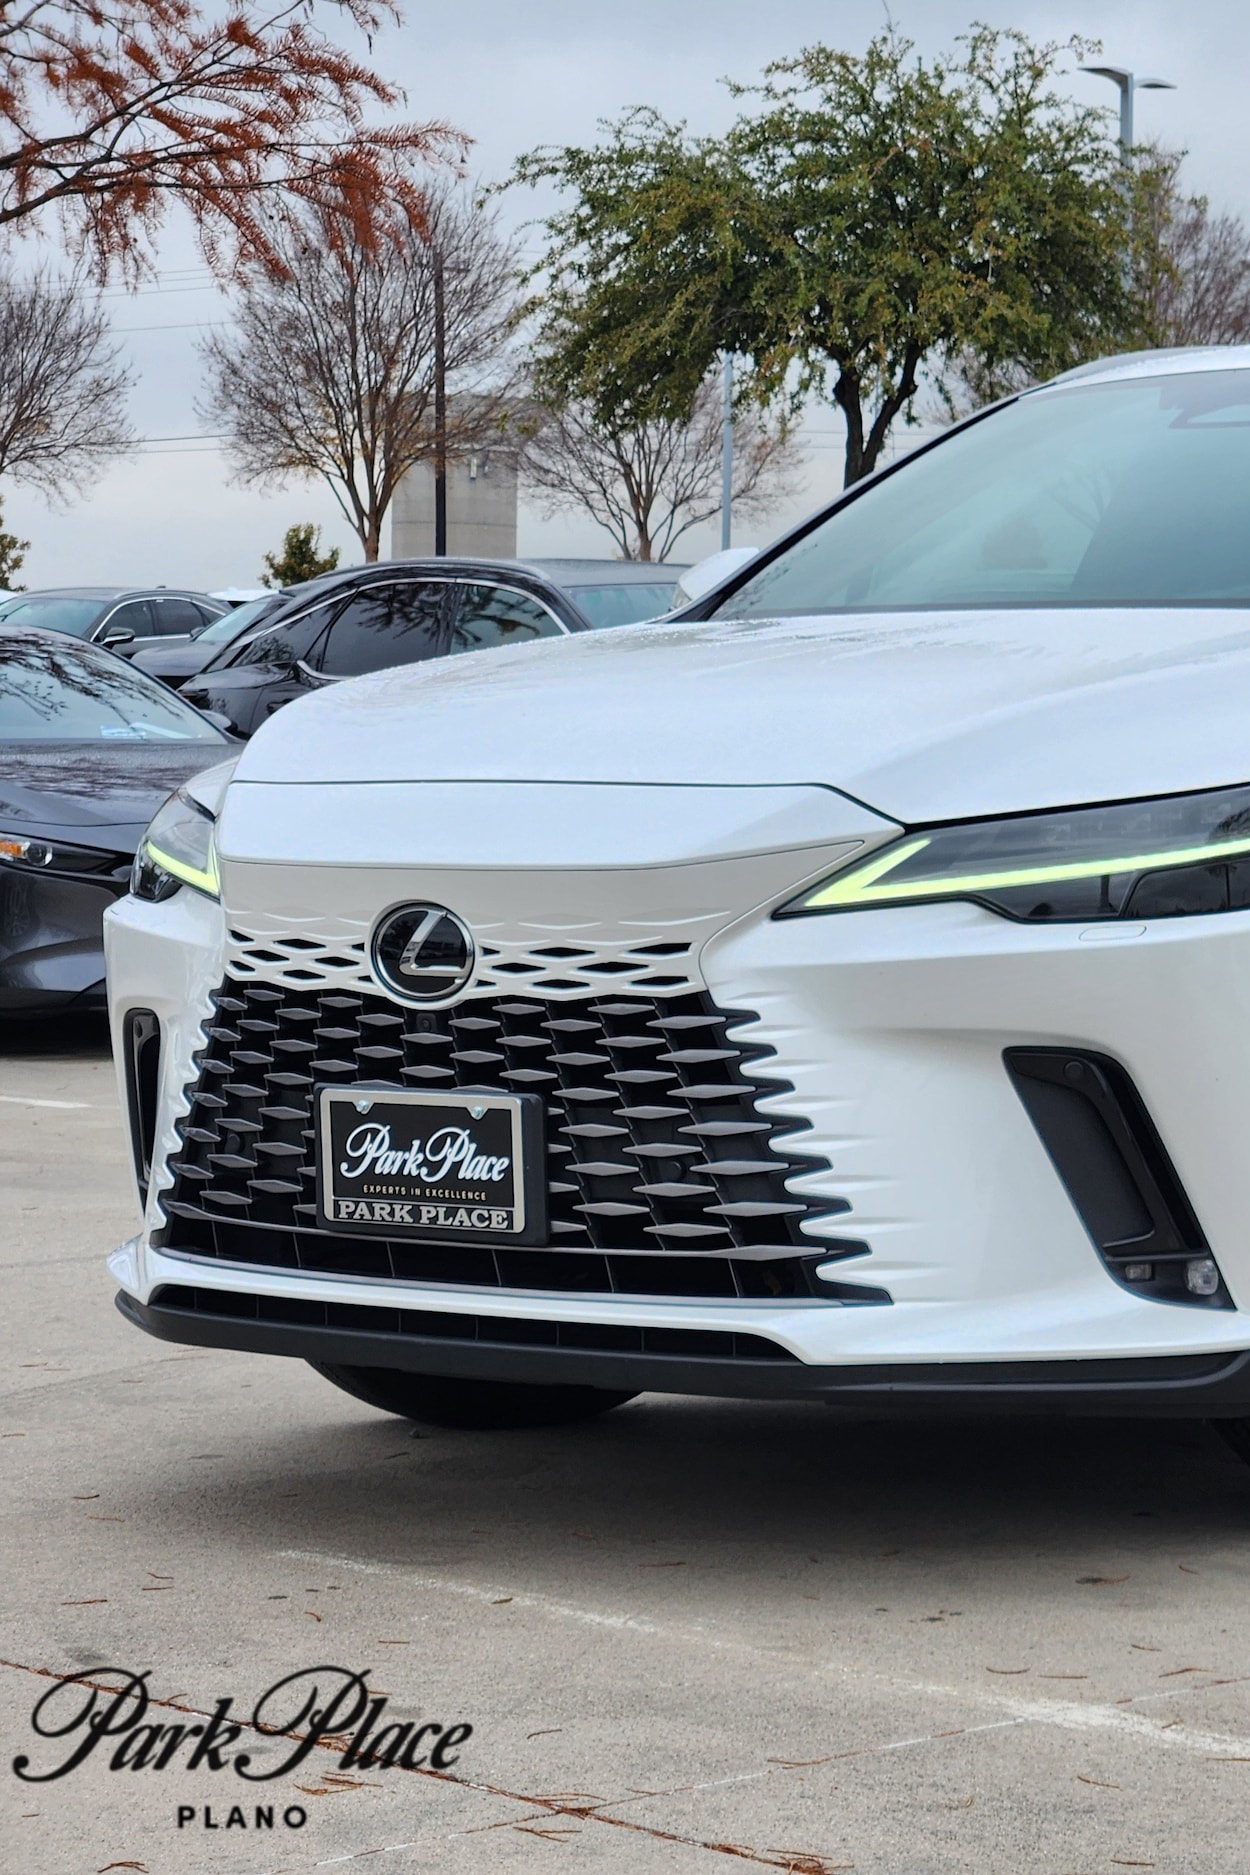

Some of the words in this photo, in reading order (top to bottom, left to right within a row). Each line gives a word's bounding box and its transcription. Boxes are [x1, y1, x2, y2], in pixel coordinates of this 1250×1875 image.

[340, 1123, 423, 1178] Park
[420, 1127, 509, 1183] Place
[363, 1184, 406, 1196] EXPERTS
[411, 1187, 421, 1197] IN
[425, 1188, 487, 1201] EXCELLENCE
[338, 1201, 413, 1223] PARK
[420, 1206, 508, 1229] PLACE
